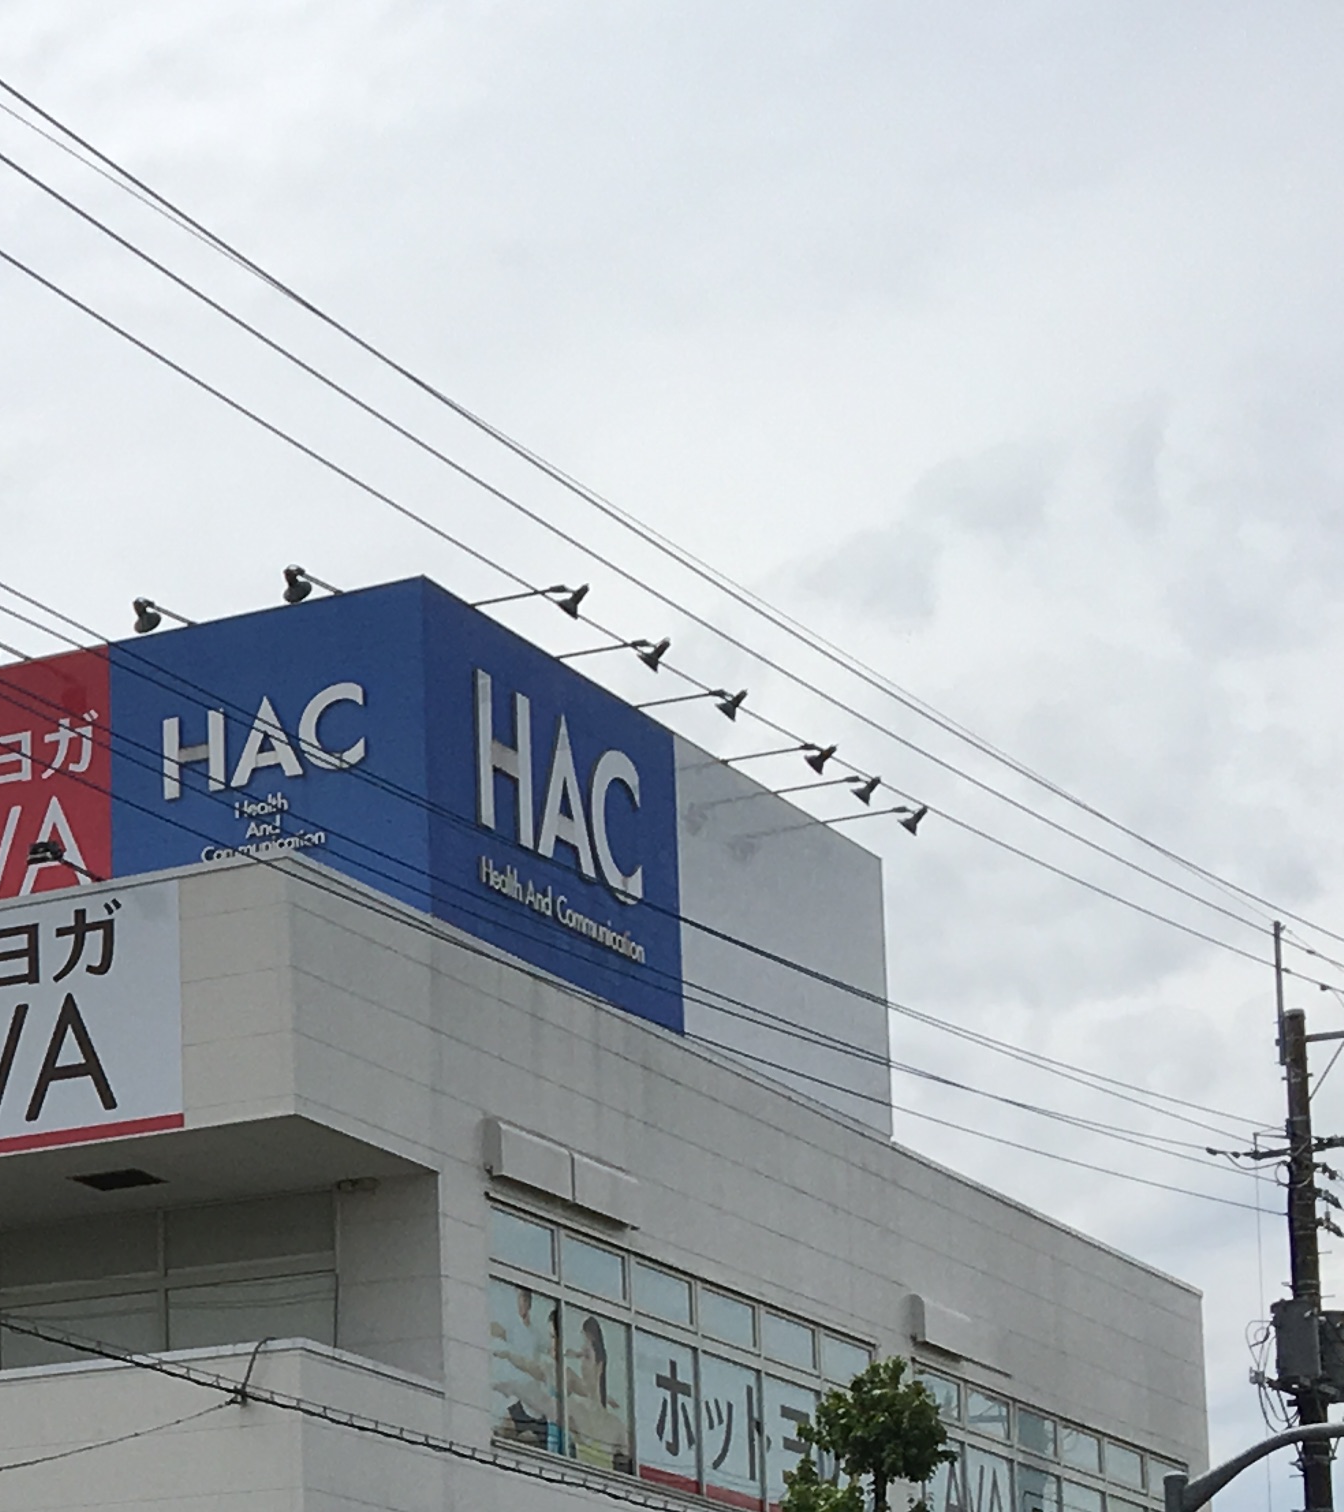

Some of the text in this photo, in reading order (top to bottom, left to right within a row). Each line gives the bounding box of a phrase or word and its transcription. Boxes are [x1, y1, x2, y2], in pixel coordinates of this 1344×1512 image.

[162, 681, 366, 801] HAC
[475, 668, 644, 906] HAC
[234, 792, 289, 819] Health
[245, 815, 281, 839] And
[480, 855, 646, 964] Health And Communication
